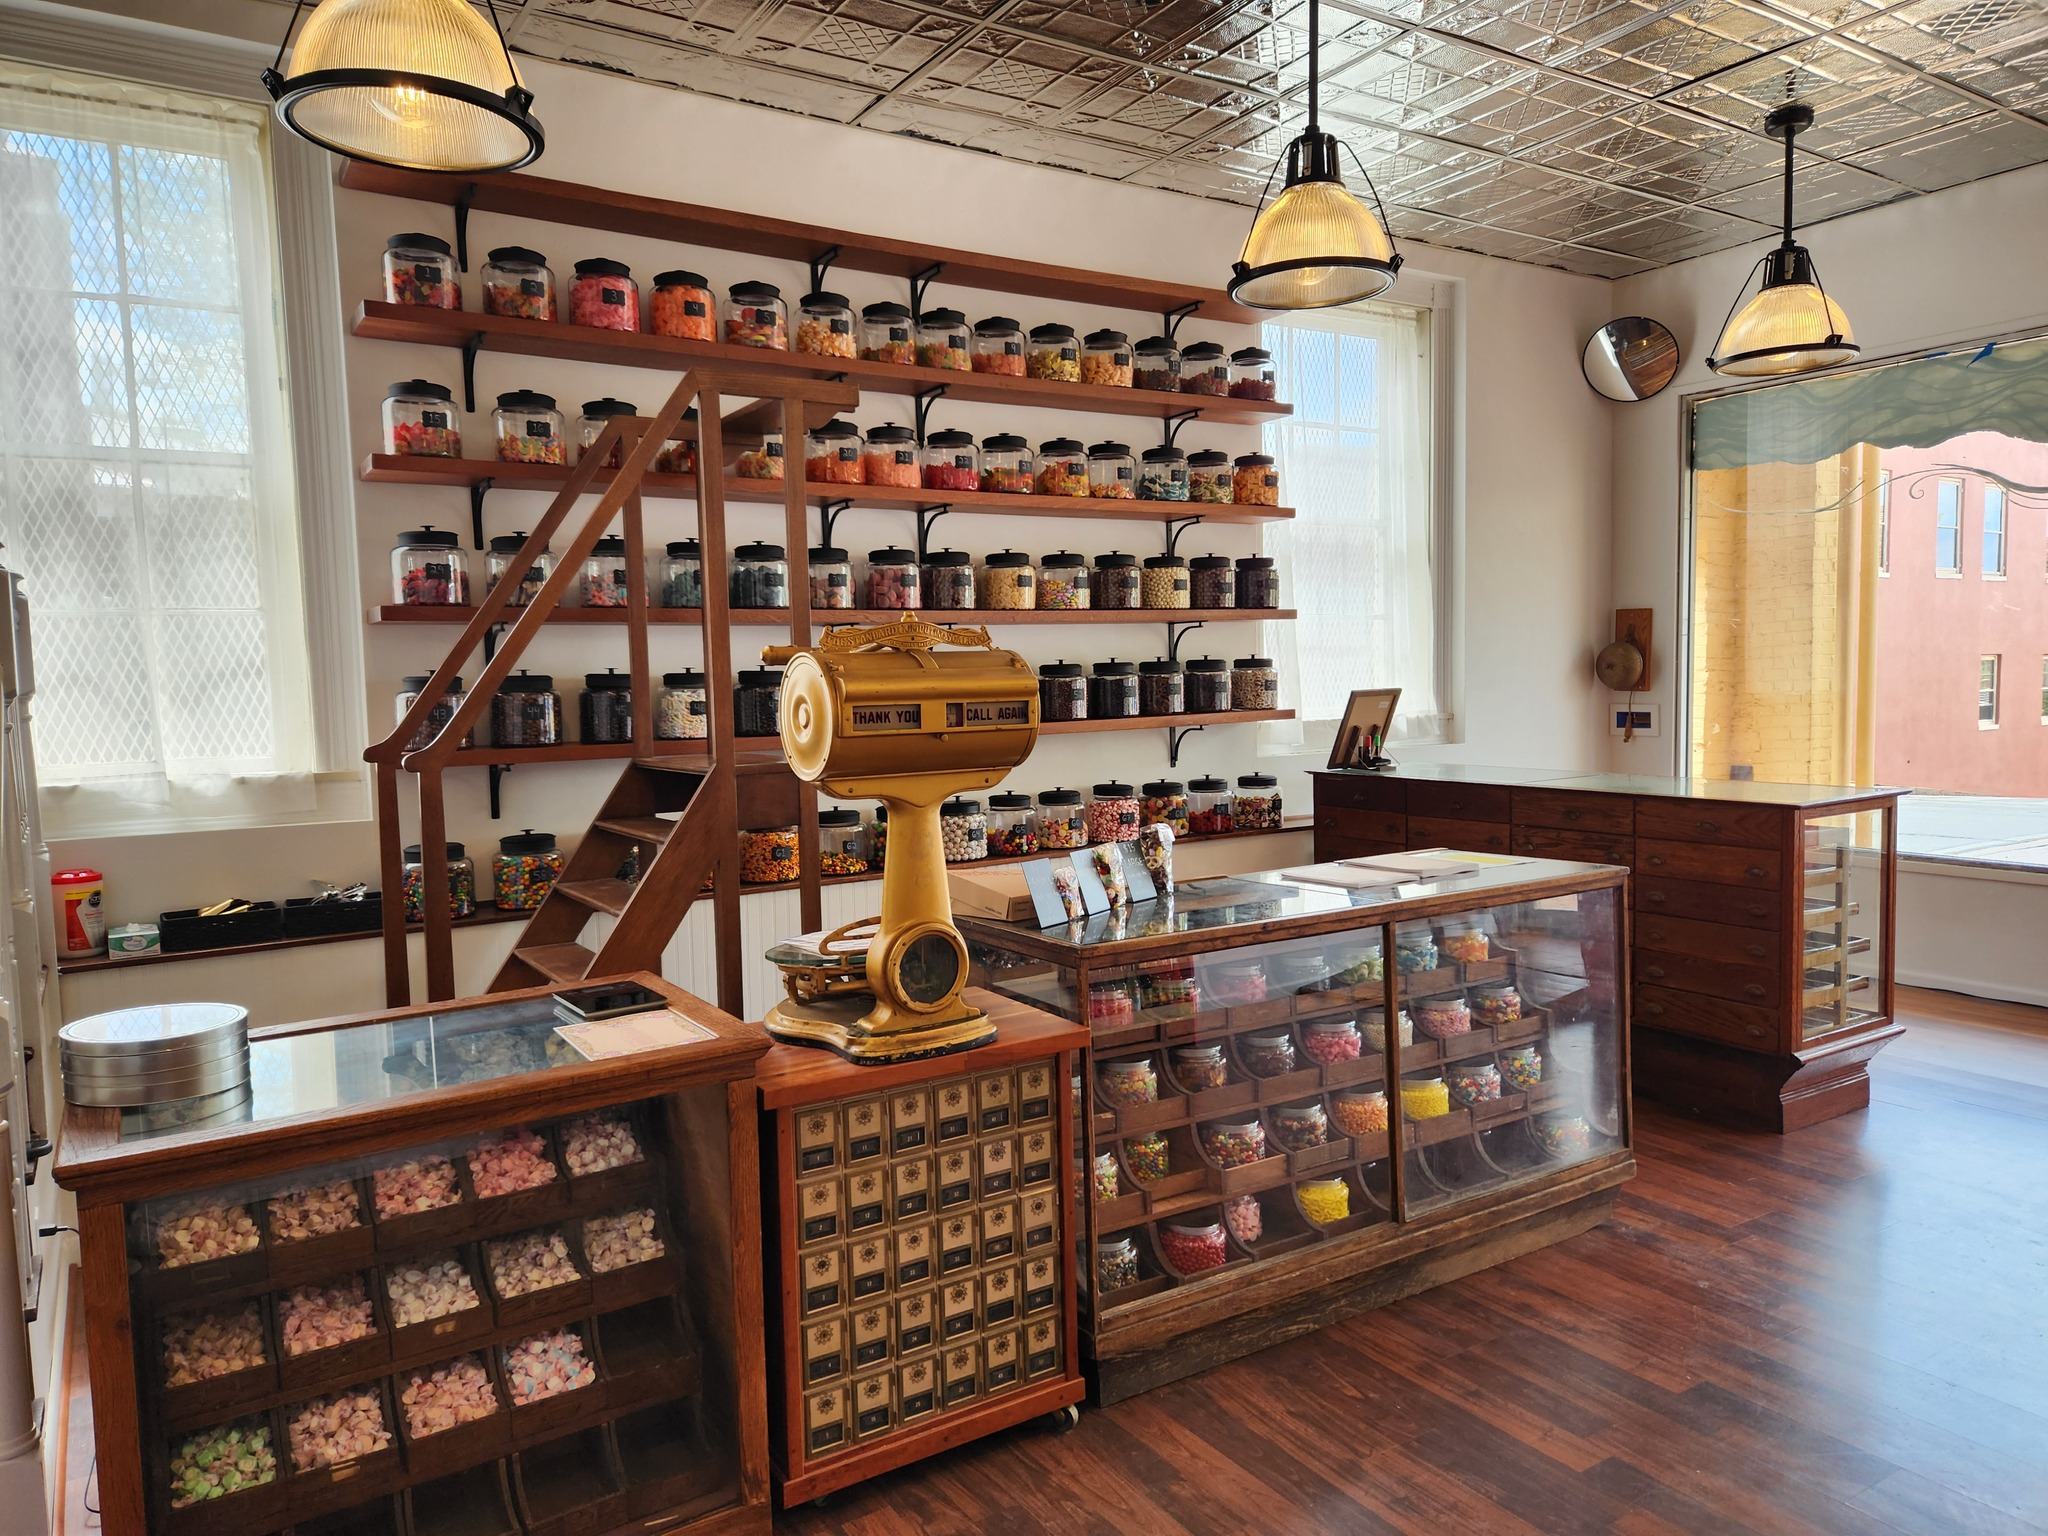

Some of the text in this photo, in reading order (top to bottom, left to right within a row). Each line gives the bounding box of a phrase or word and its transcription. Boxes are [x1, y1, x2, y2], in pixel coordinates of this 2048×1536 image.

[425, 267, 431, 278] 1
[530, 282, 538, 293] 2
[611, 290, 618, 302] 3
[692, 303, 699, 312] 4
[763, 312, 770, 322] 5
[837, 320, 844, 331] 6
[896, 329, 902, 338] 7
[955, 336, 960, 346] 8
[1010, 343, 1017, 353] 9
[1065, 349, 1074, 359] 10
[429, 413, 441, 424] 15
[532, 423, 544, 433] 16
[772, 443, 781, 454] 19
[899, 452, 909, 461] 21
[430, 565, 444, 575] 29
[769, 575, 780, 585] 33
[827, 635, 847, 646] THE
[848, 626, 898, 646] STANDARD
[899, 624, 947, 642] COMPUTING
[947, 633, 973, 645] SCALE
[527, 707, 540, 717] 44
[615, 704, 627, 716] 45
[694, 703, 706, 713] 46
[433, 708, 447, 720] 43
[853, 710, 919, 724] THANK YOU
[966, 708, 992, 721] CALL
[997, 706, 1027, 720] AGAIN
[533, 870, 547, 881] 58
